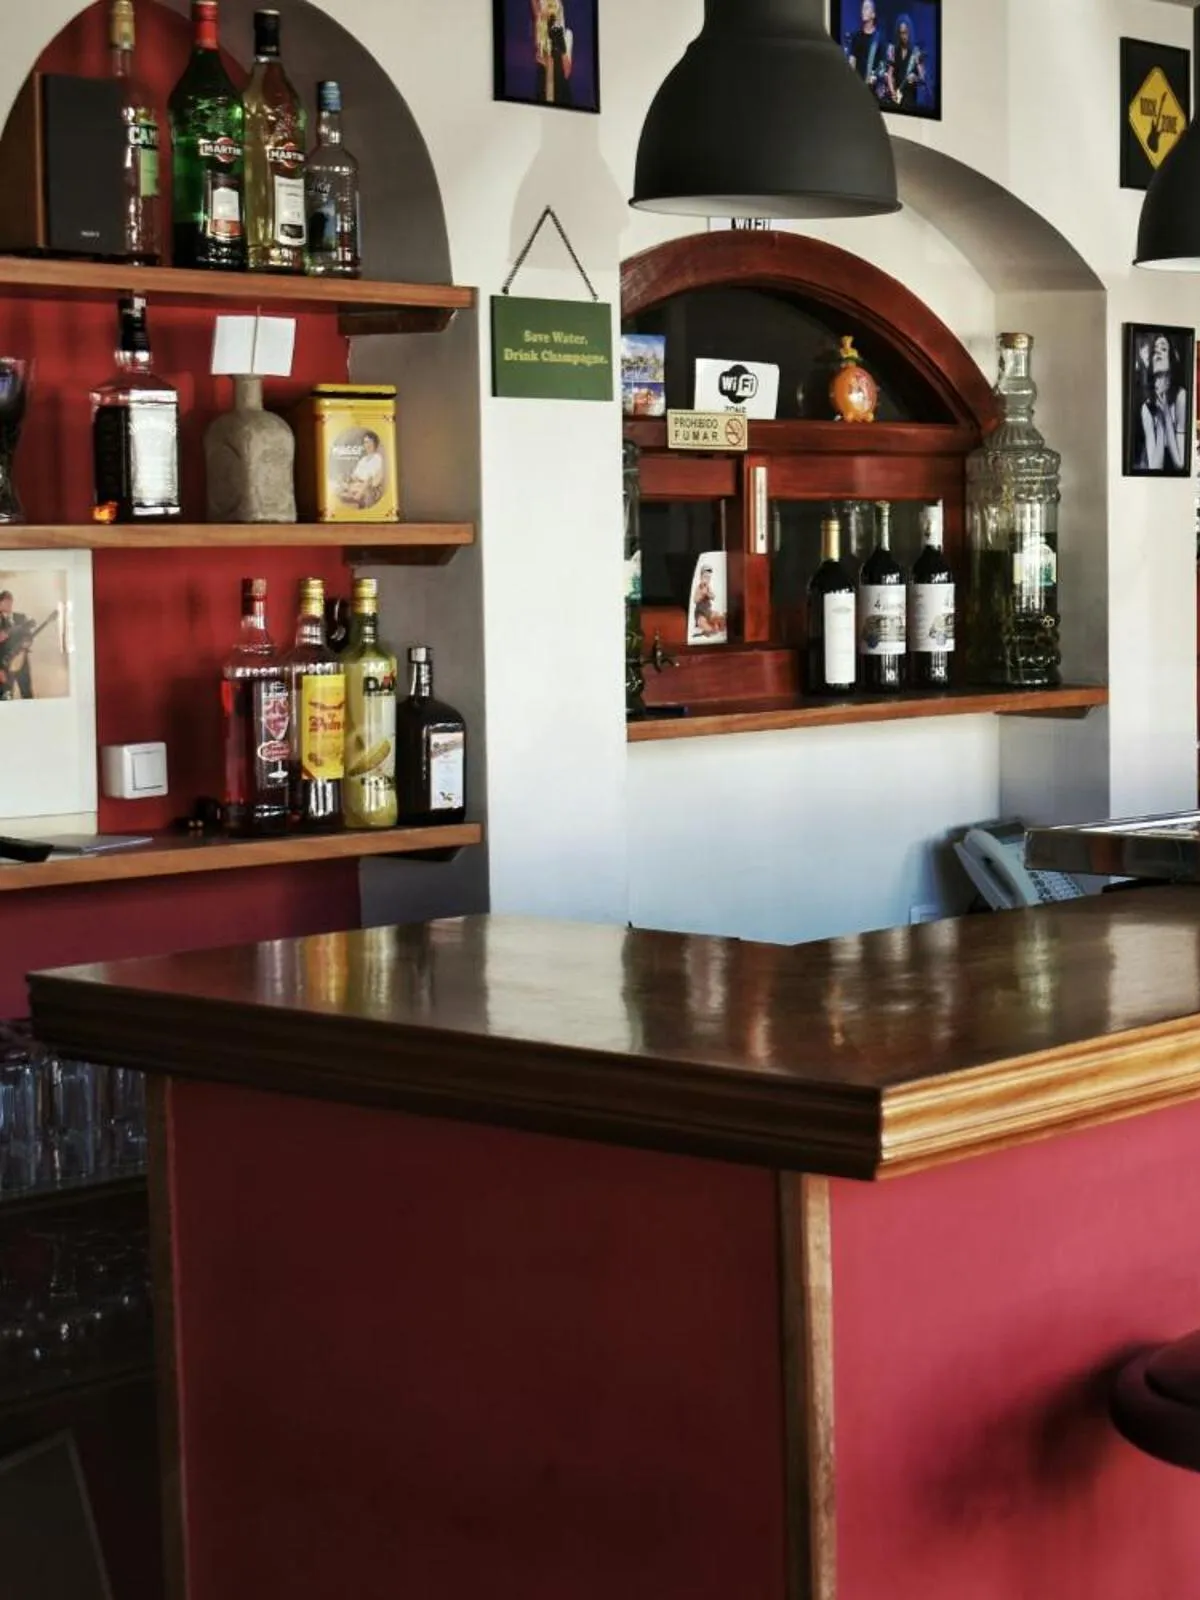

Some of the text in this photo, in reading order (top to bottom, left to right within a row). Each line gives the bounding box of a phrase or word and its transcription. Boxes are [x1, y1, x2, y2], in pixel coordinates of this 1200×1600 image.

[523, 330, 550, 343] Save
[503, 347, 540, 362] Drink
[674, 417, 718, 429] PROHIBIDO
[674, 430, 718, 441] FUMAR
